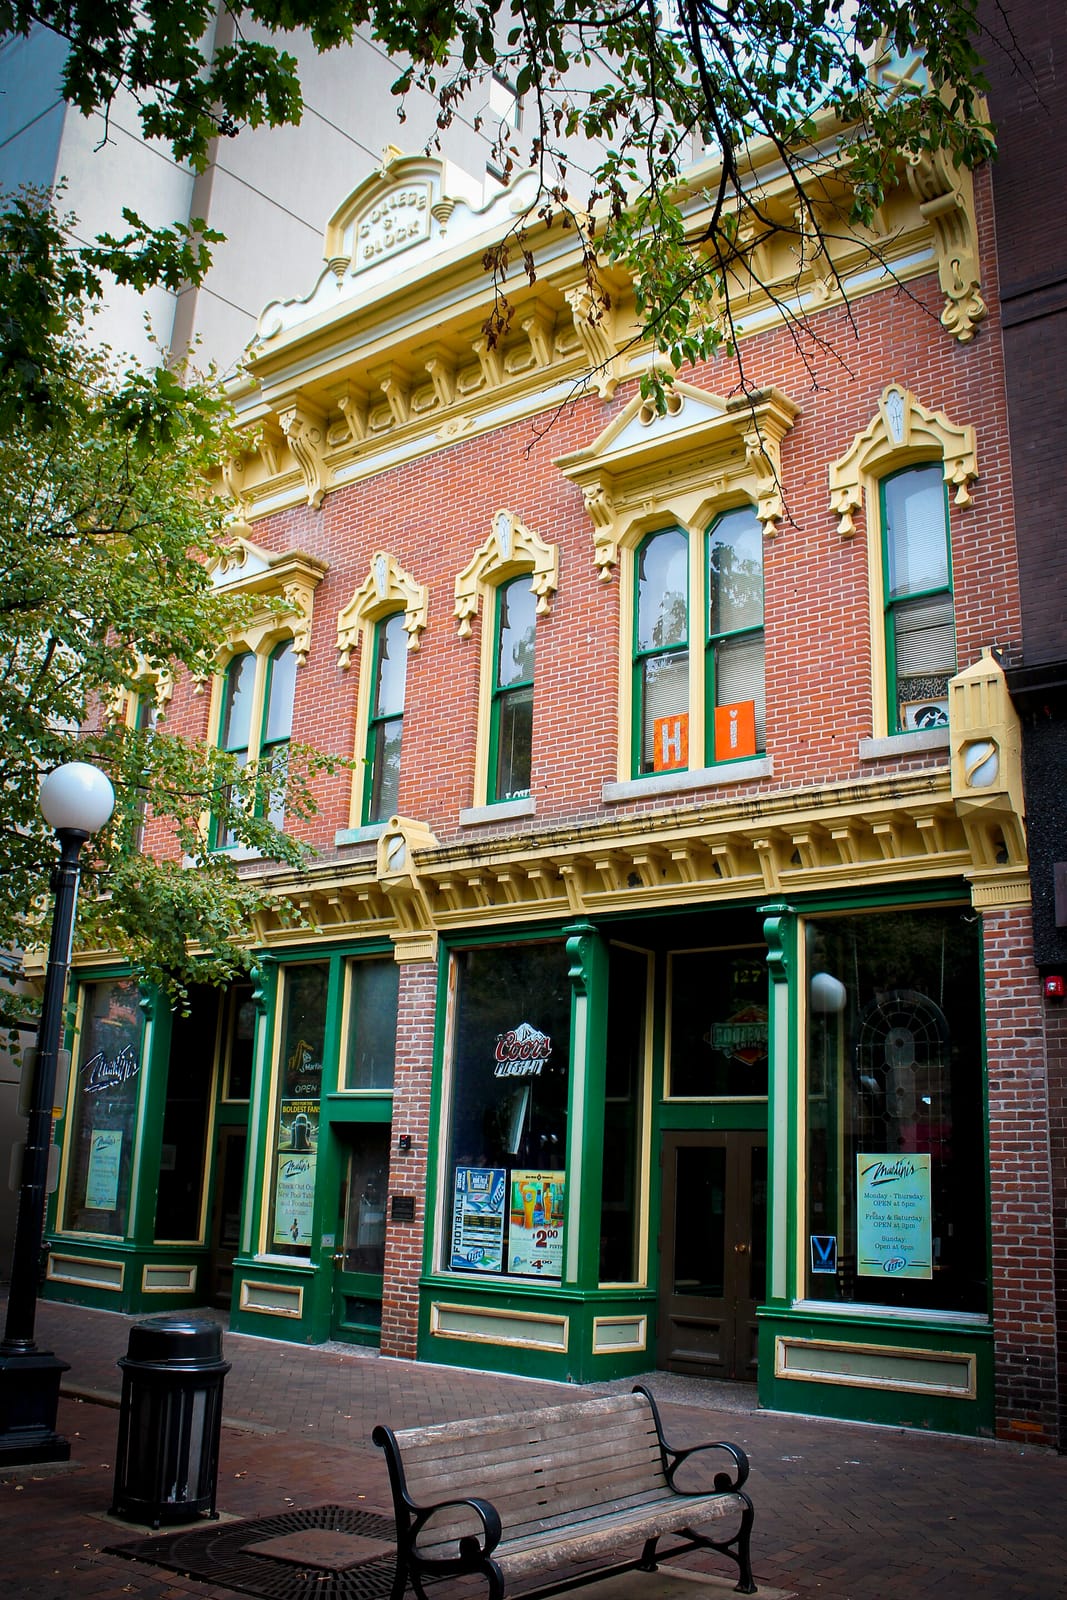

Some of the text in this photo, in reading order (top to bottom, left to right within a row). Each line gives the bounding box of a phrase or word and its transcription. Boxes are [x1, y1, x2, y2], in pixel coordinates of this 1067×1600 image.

[360, 192, 426, 238] COLLEGE
[363, 220, 420, 259] BLOCK
[495, 1030, 553, 1062] Coors
[294, 1084, 318, 1094] OPEN
[864, 1192, 888, 1200] Monday
[893, 1192, 924, 1201] Thursday
[865, 1213, 886, 1221] Friday
[893, 1214, 923, 1223] Saturday
[453, 1195, 464, 1254] FOOTBALL
[881, 1235, 905, 1243] Sunday
[874, 1242, 891, 1251] Open
